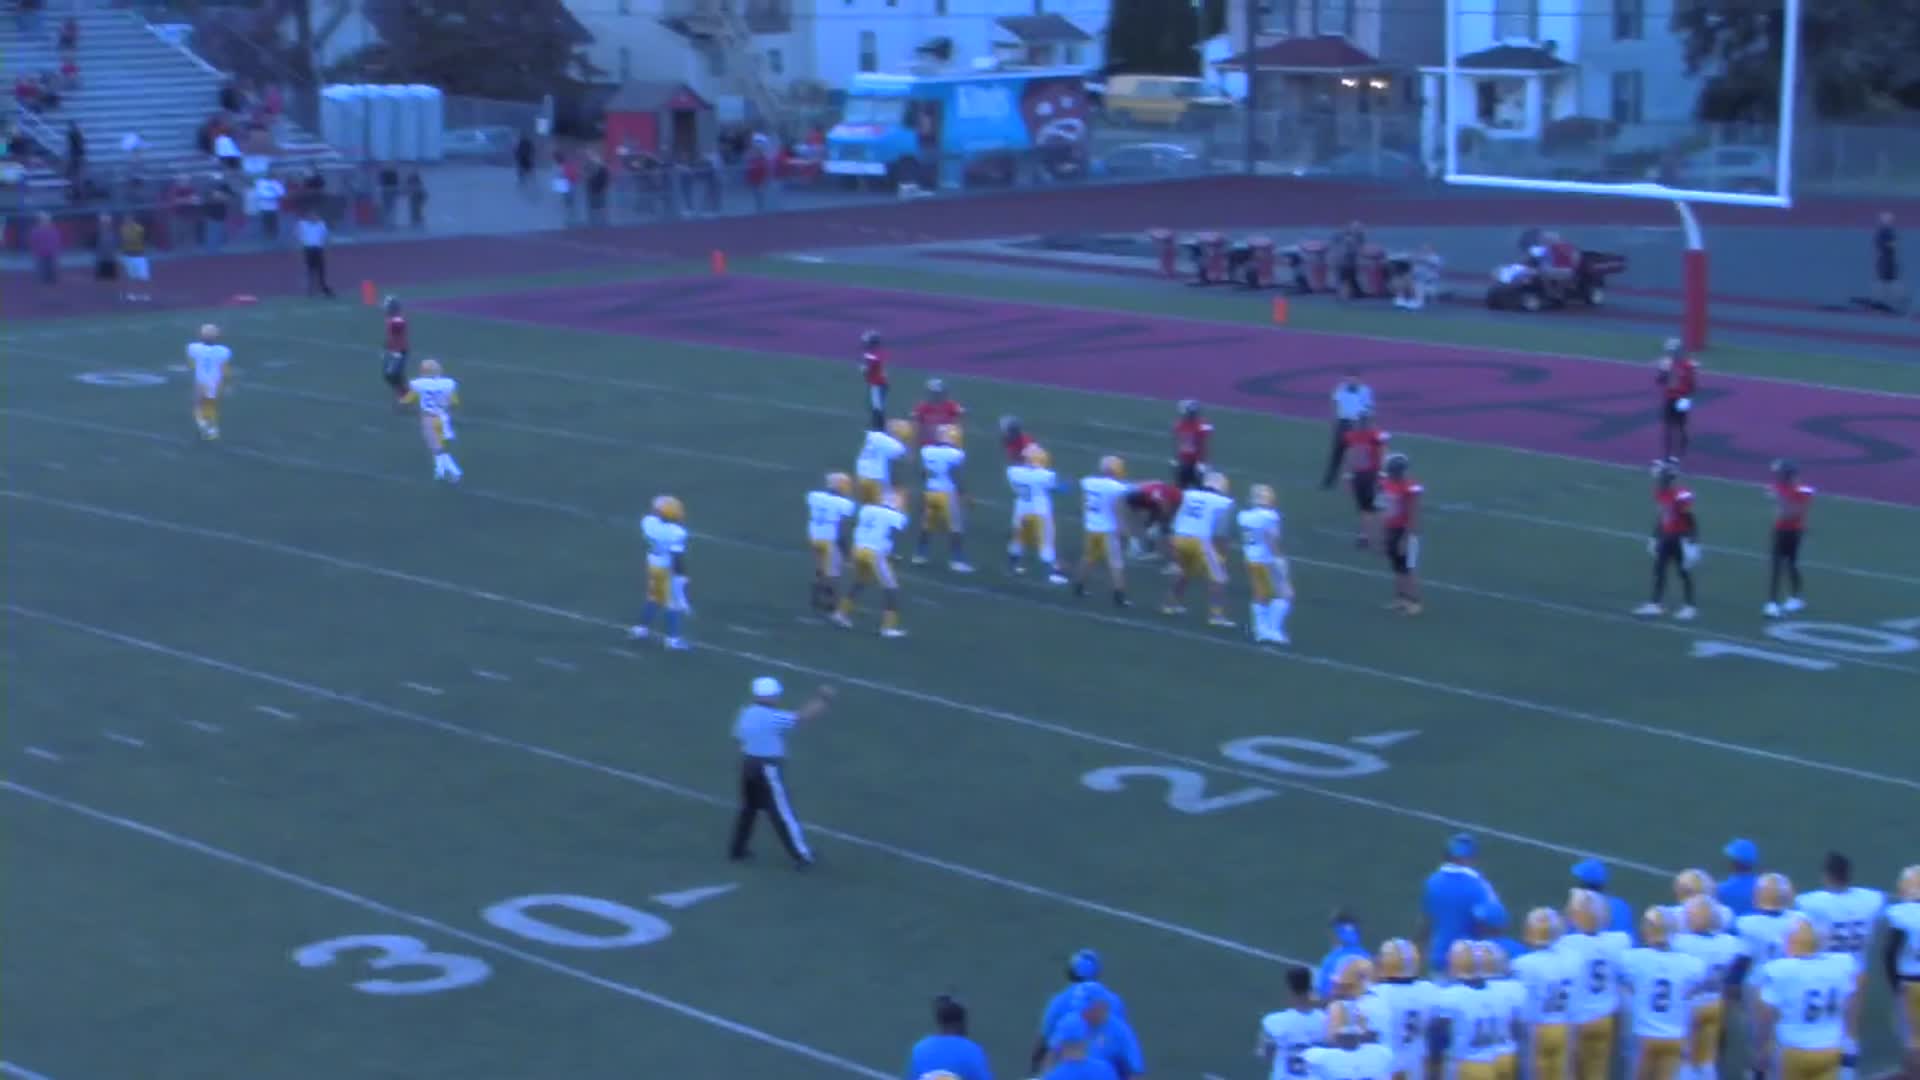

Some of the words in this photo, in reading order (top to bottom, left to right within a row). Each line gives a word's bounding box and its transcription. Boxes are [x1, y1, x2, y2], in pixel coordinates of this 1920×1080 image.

[1692, 620, 1920, 671] 10
[1080, 735, 1390, 815] 20
[292, 893, 673, 996] 30
[1651, 977, 1671, 1013] 2
